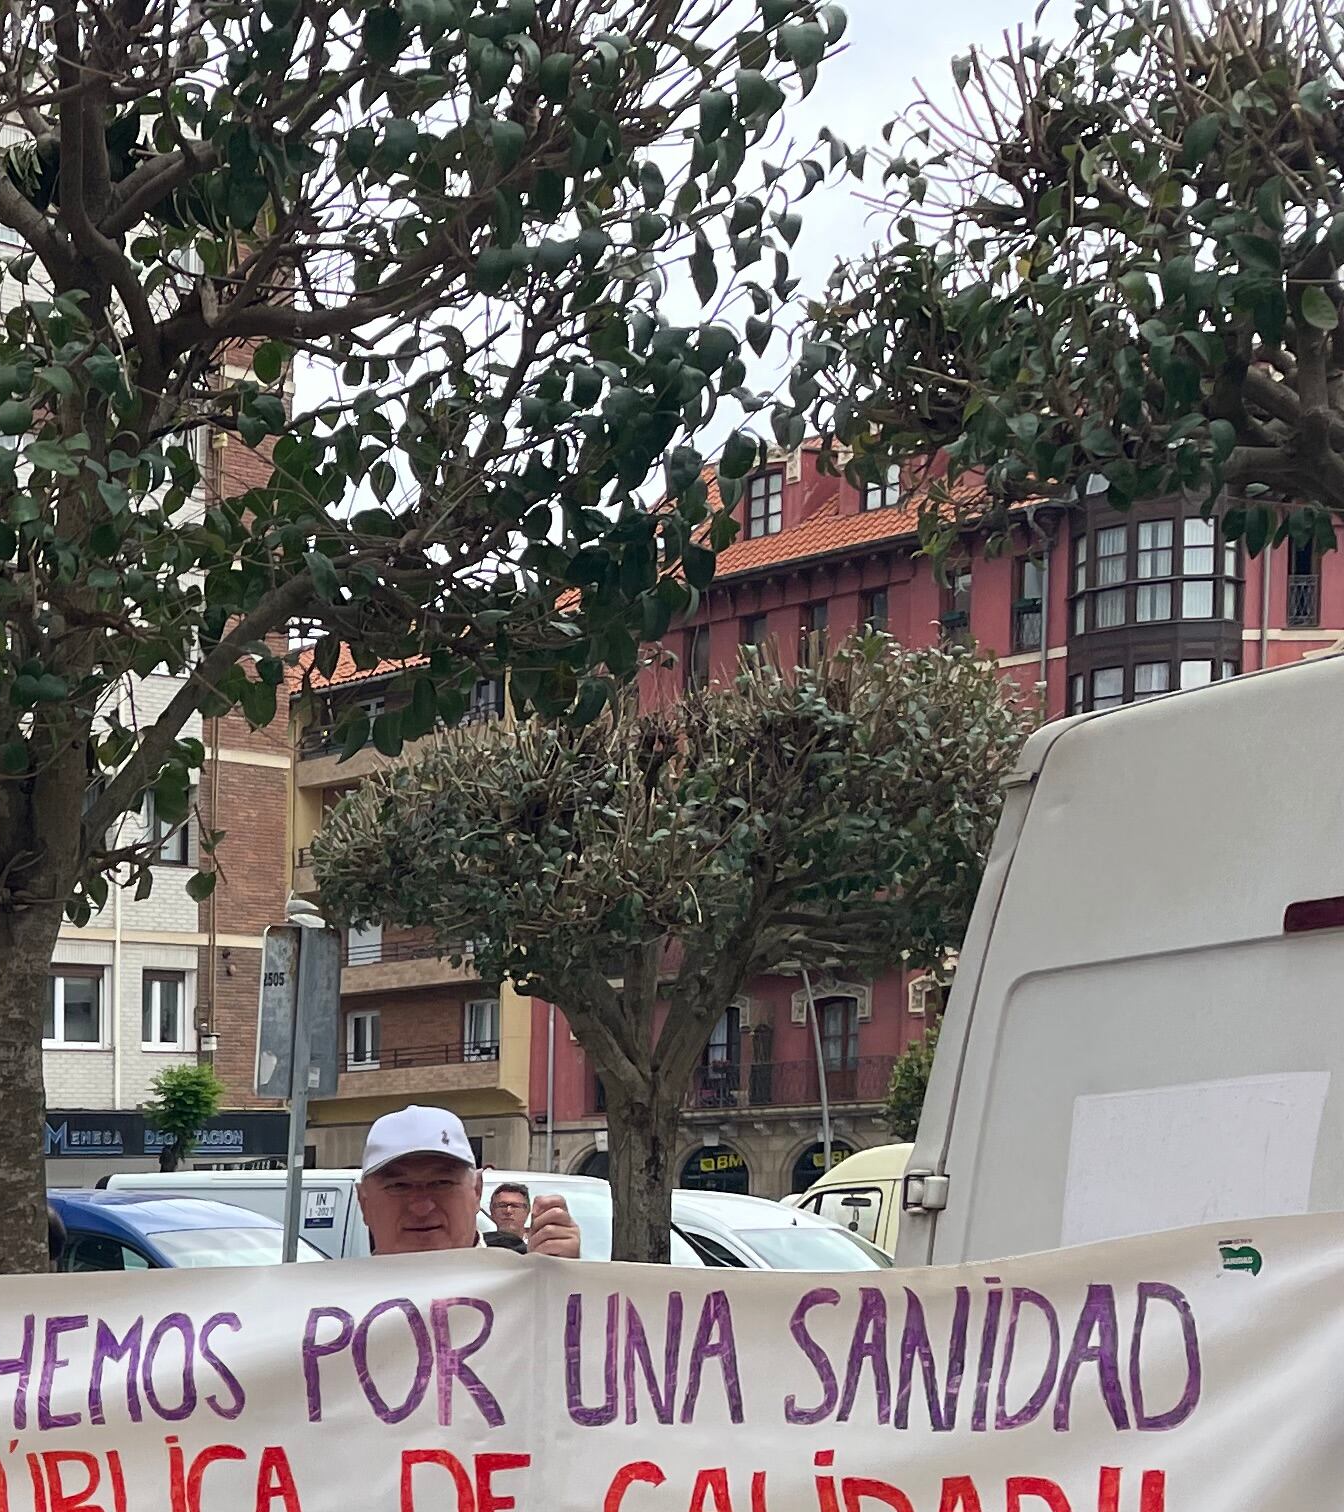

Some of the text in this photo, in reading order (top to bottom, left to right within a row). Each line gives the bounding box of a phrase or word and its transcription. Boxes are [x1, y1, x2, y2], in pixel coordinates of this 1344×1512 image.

[144, 1129, 244, 1146] DEGTACION
[301, 1297, 506, 1427] POR
[564, 1282, 745, 1427] UNA
[783, 1276, 1201, 1433] SANIDAD
